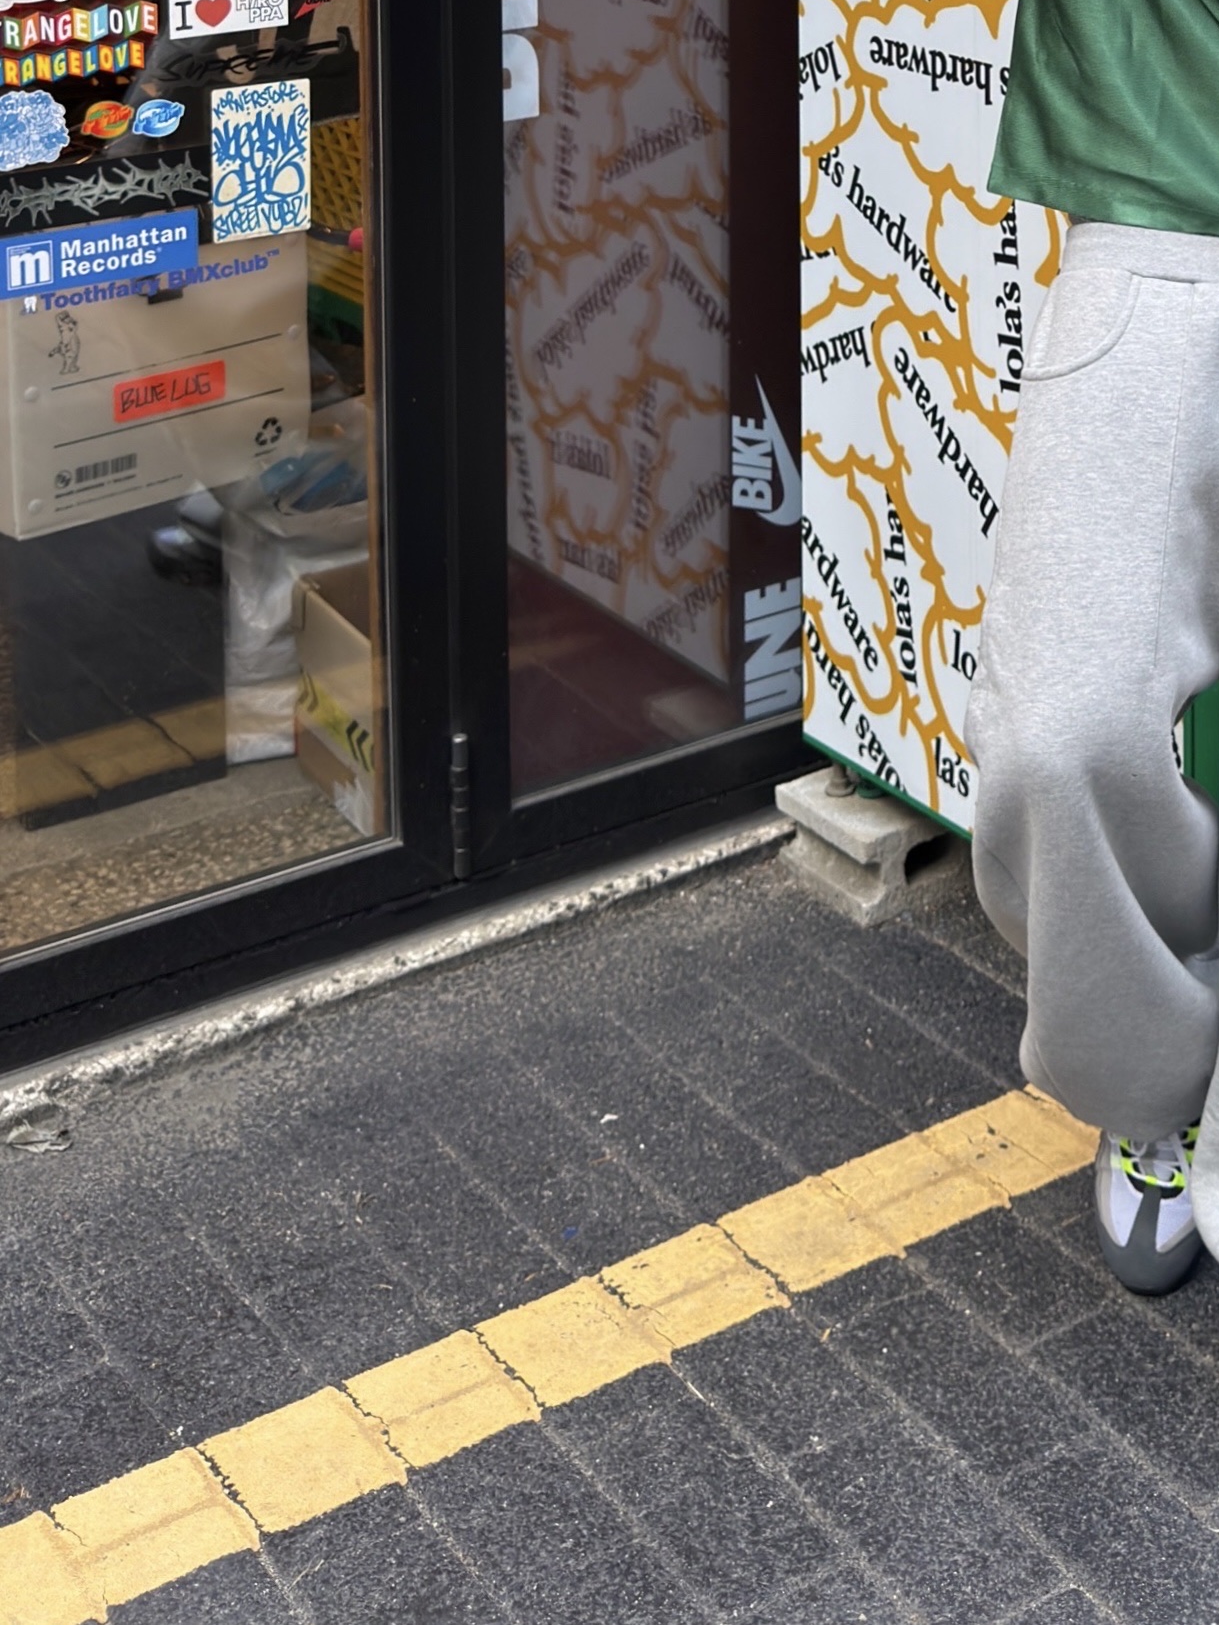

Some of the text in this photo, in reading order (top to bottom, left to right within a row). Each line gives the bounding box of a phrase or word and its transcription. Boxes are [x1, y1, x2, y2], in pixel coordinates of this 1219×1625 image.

[175, 0, 193, 31] I
[249, 6, 284, 23] PPA
[869, 35, 994, 106] hardware
[60, 226, 187, 259] Manhattan
[61, 248, 158, 278] Records
[41, 276, 161, 312] Toothfairy
[119, 380, 167, 413] BLUE
[893, 346, 1000, 539] hardware
[732, 414, 774, 512] BIKE
